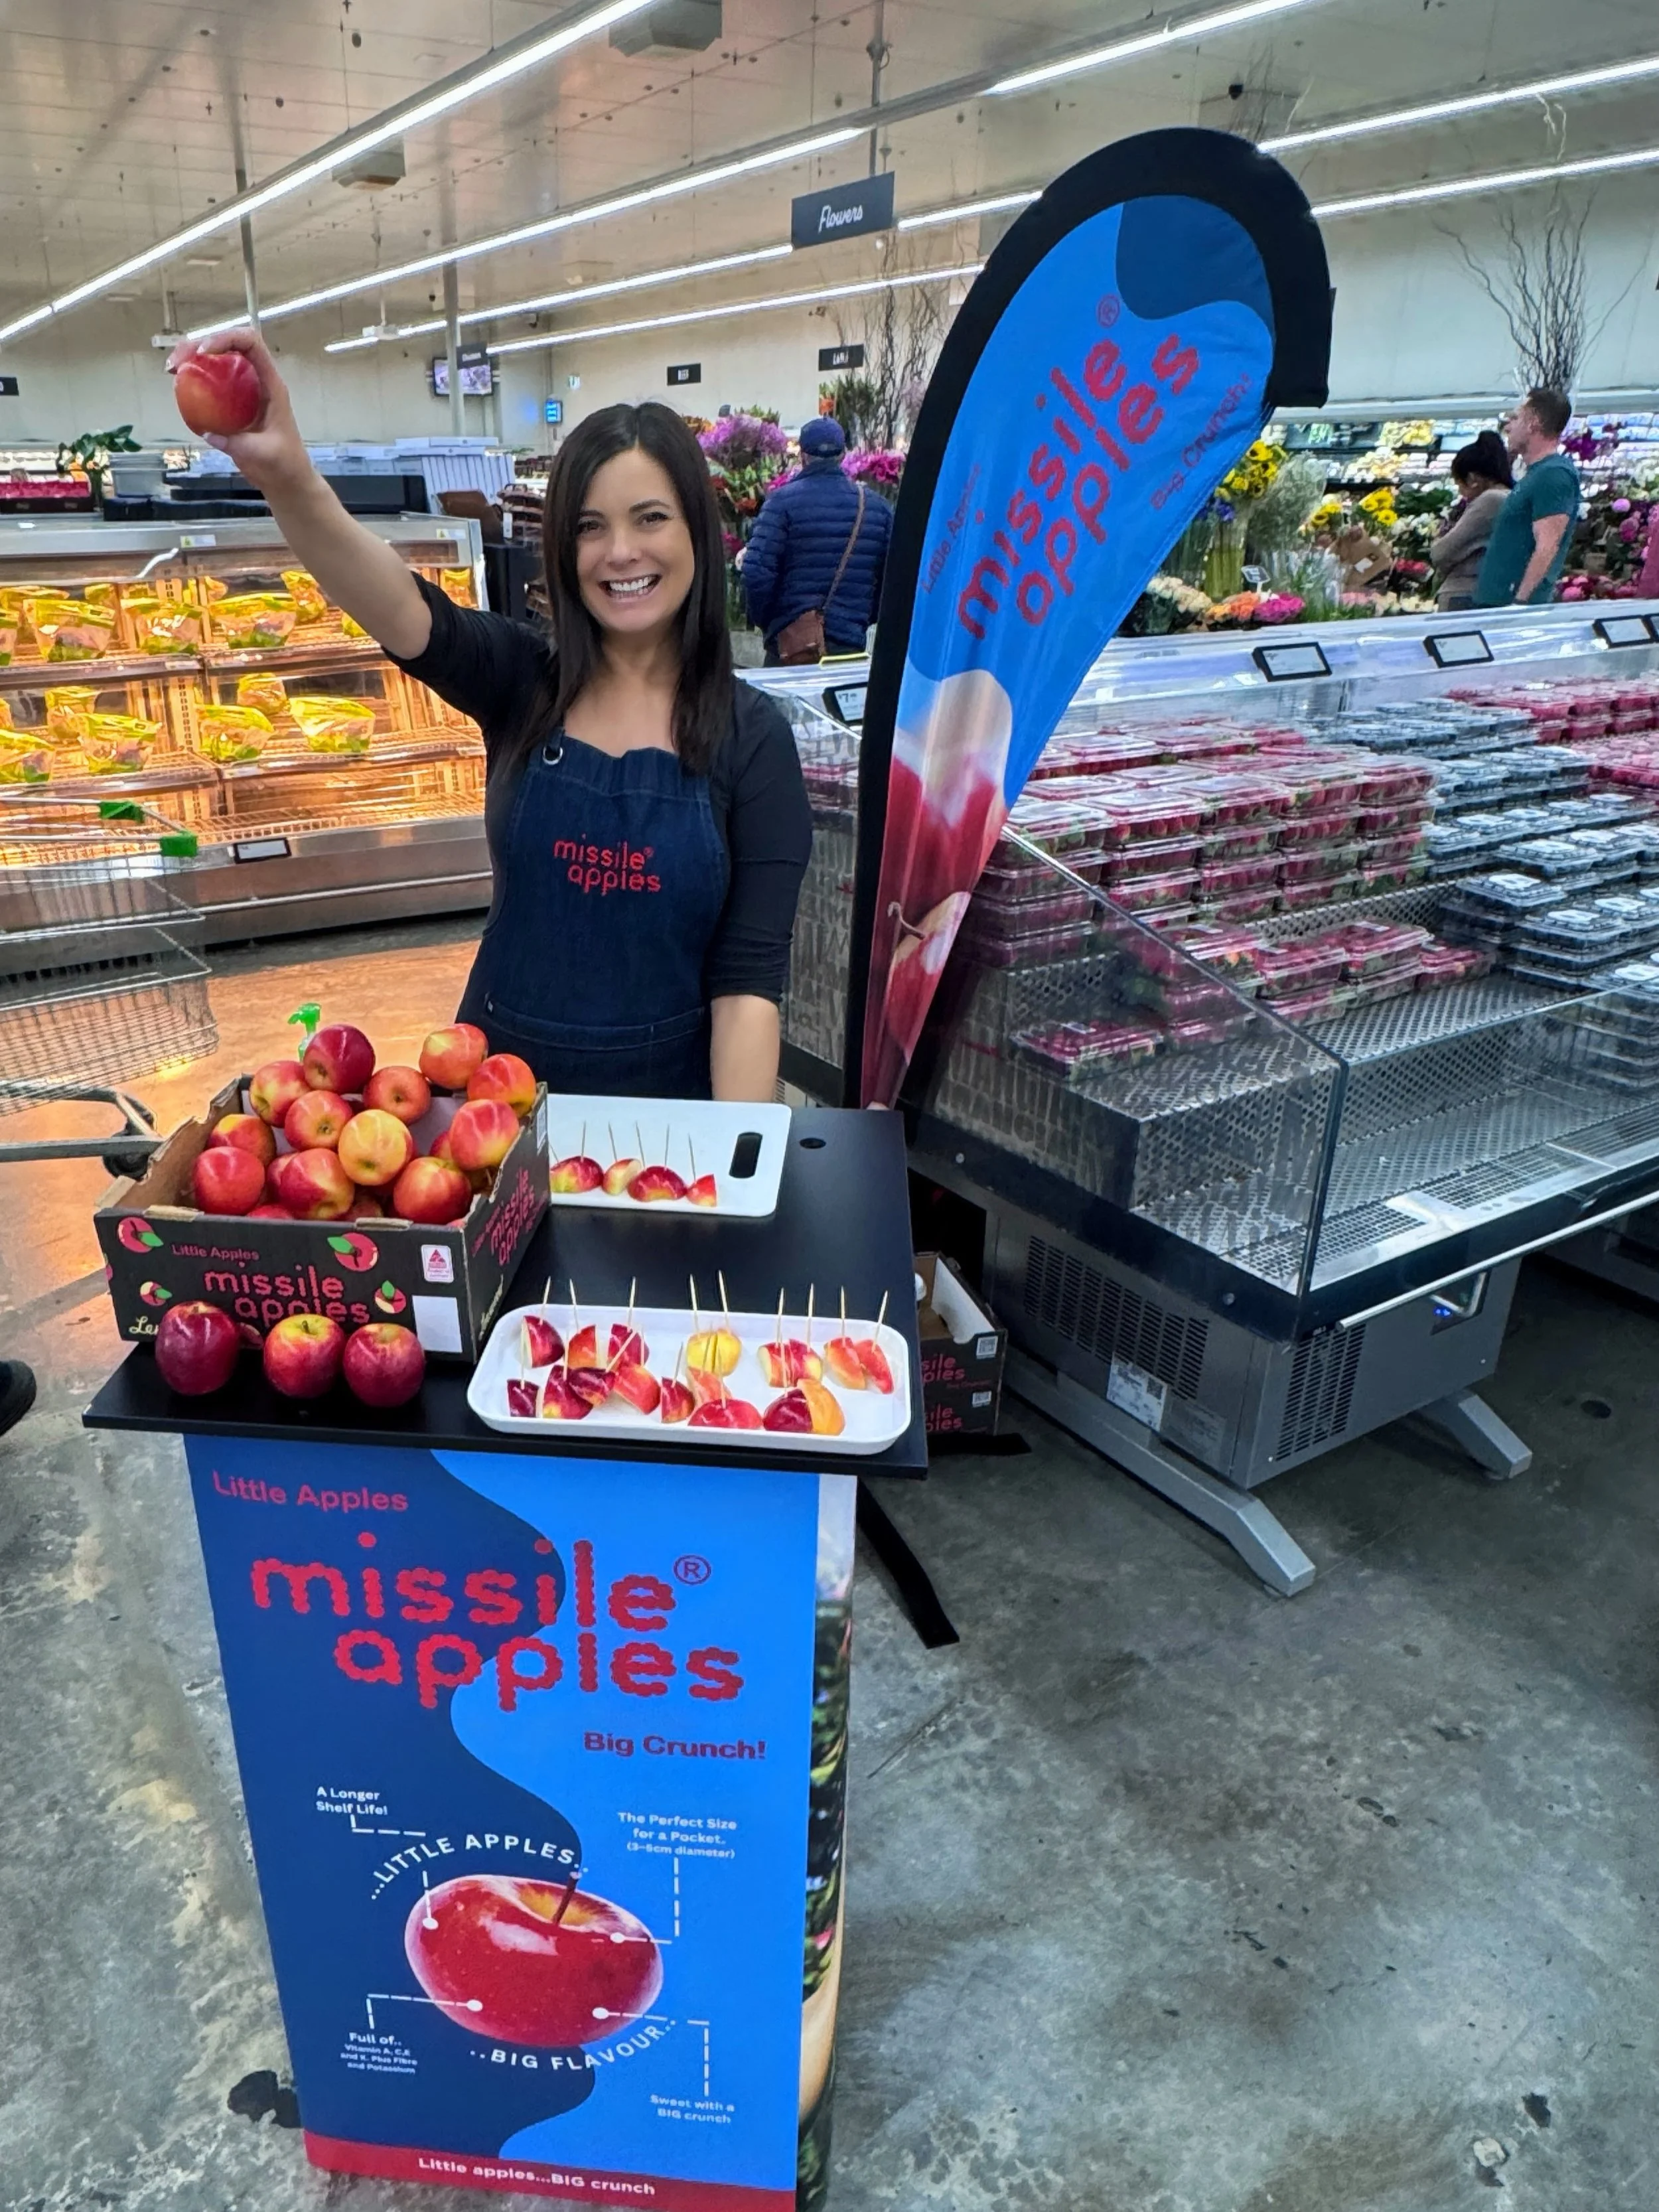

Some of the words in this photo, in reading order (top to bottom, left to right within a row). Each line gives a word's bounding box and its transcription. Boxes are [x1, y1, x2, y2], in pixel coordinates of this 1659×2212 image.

[818, 204, 863, 234] Flowers
[1017, 333, 1199, 626] apples
[1150, 471, 1184, 510] Big
[568, 865, 661, 896] apples
[171, 1244, 207, 1258] Little
[210, 1246, 259, 1261] Apples
[204, 1262, 344, 1299] missile
[212, 1469, 287, 1505] Little
[297, 1485, 409, 1513] Apples
[334, 1630, 745, 1712] apples
[584, 1732, 634, 1757] Big
[643, 1735, 766, 1760] Crunch!
[317, 1786, 327, 1797] A
[330, 1787, 380, 1802] Longer
[316, 1801, 354, 1813] Shelf
[356, 1804, 388, 1815] Life!
[618, 1812, 646, 1824] The
[648, 1814, 703, 1829] Perfect
[707, 1818, 737, 1830] Size
[632, 1827, 655, 1839] for
[658, 1831, 668, 1841] a
[670, 1831, 727, 1845] Pocket.
[674, 1846, 736, 1860] diameter)
[349, 2032, 376, 2044] Full
[344, 2043, 382, 2054] Vitamin
[650, 2094, 691, 2108] Sweet
[694, 2101, 723, 2111] with
[657, 2107, 682, 2120] BIG
[684, 2112, 731, 2124] crunch
[419, 2157, 467, 2174] Little
[591, 2179, 656, 2195] crunch
